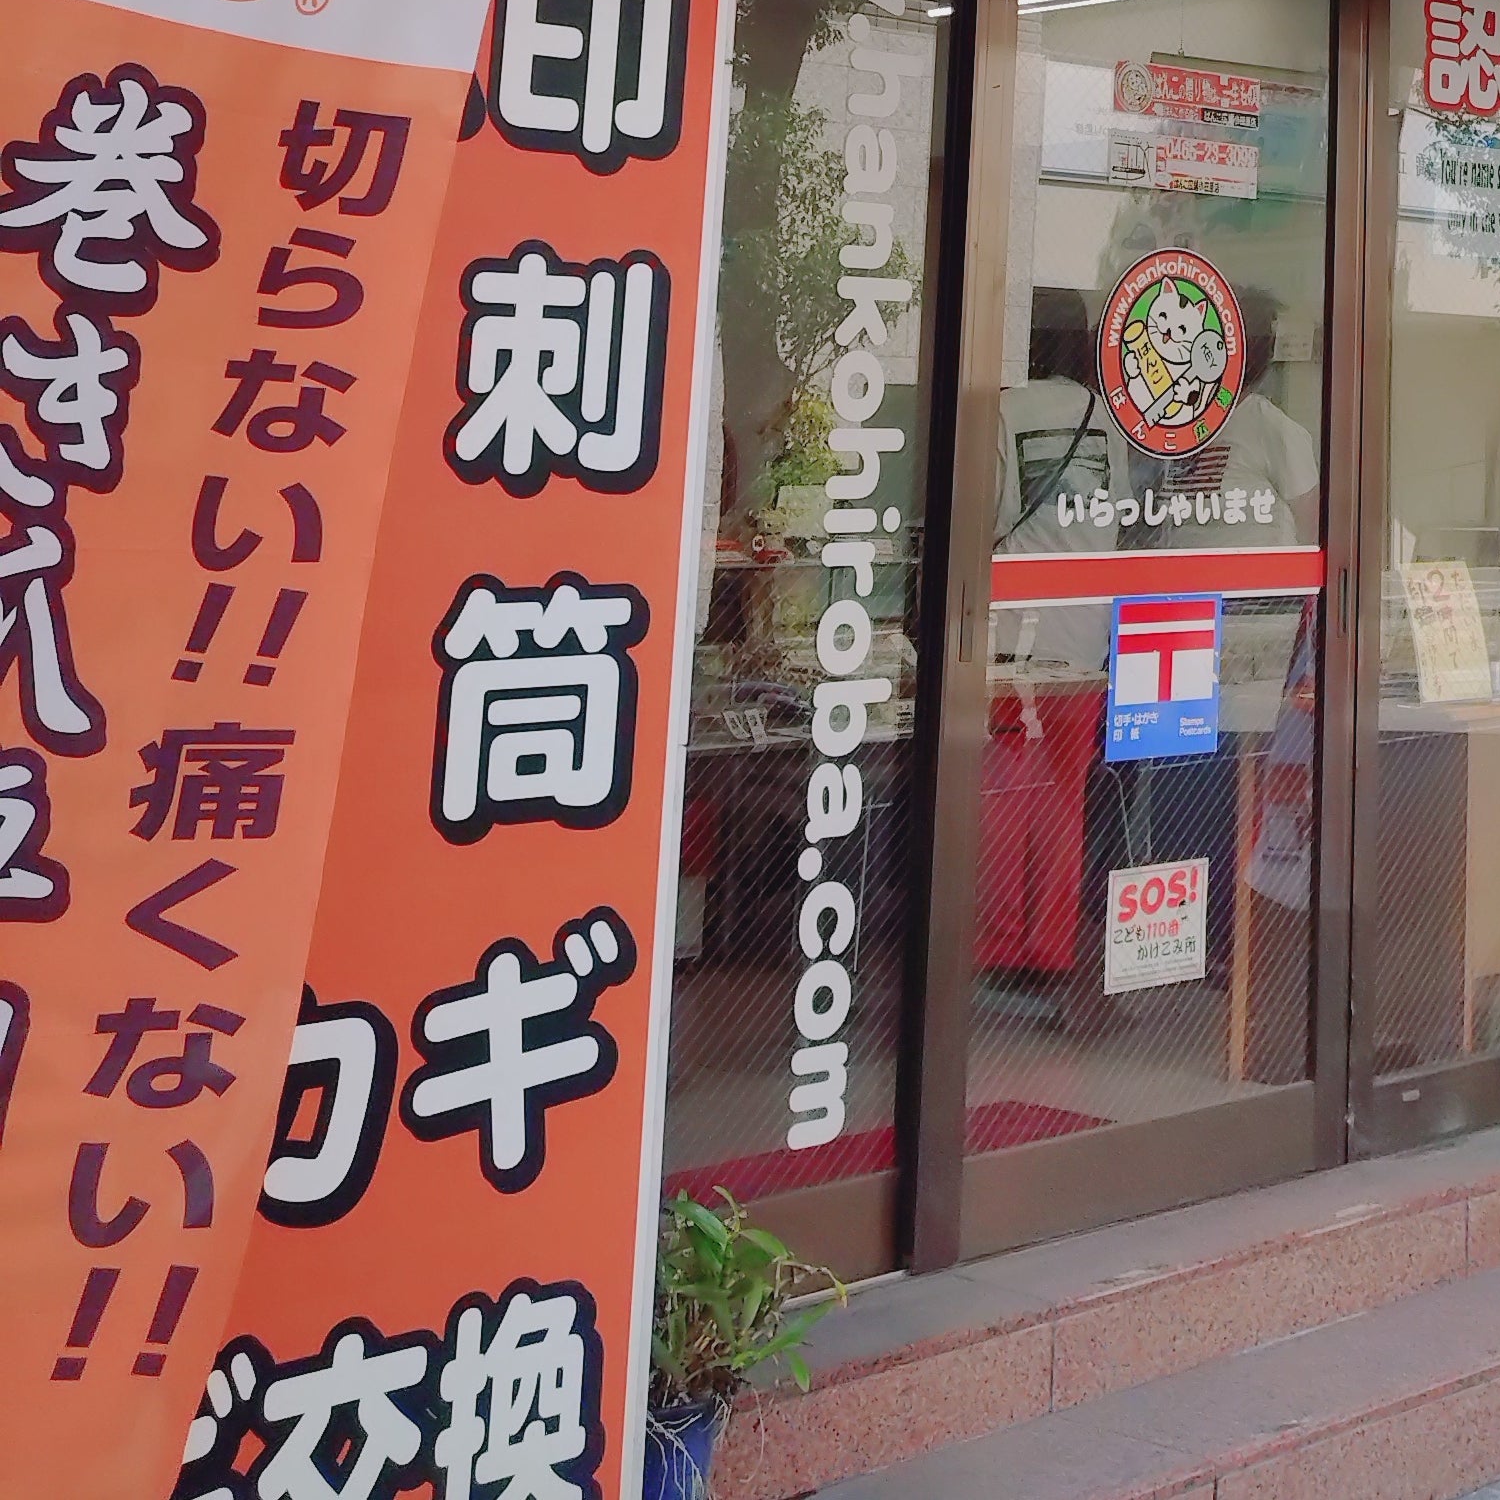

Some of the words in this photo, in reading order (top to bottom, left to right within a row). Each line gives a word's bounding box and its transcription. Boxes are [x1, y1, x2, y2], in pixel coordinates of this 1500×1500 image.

[1108, 256, 1238, 357] www.hankohiroba.com
[1057, 488, 1277, 528] いらっしゃいませ
[1117, 865, 1199, 924] SOS!
